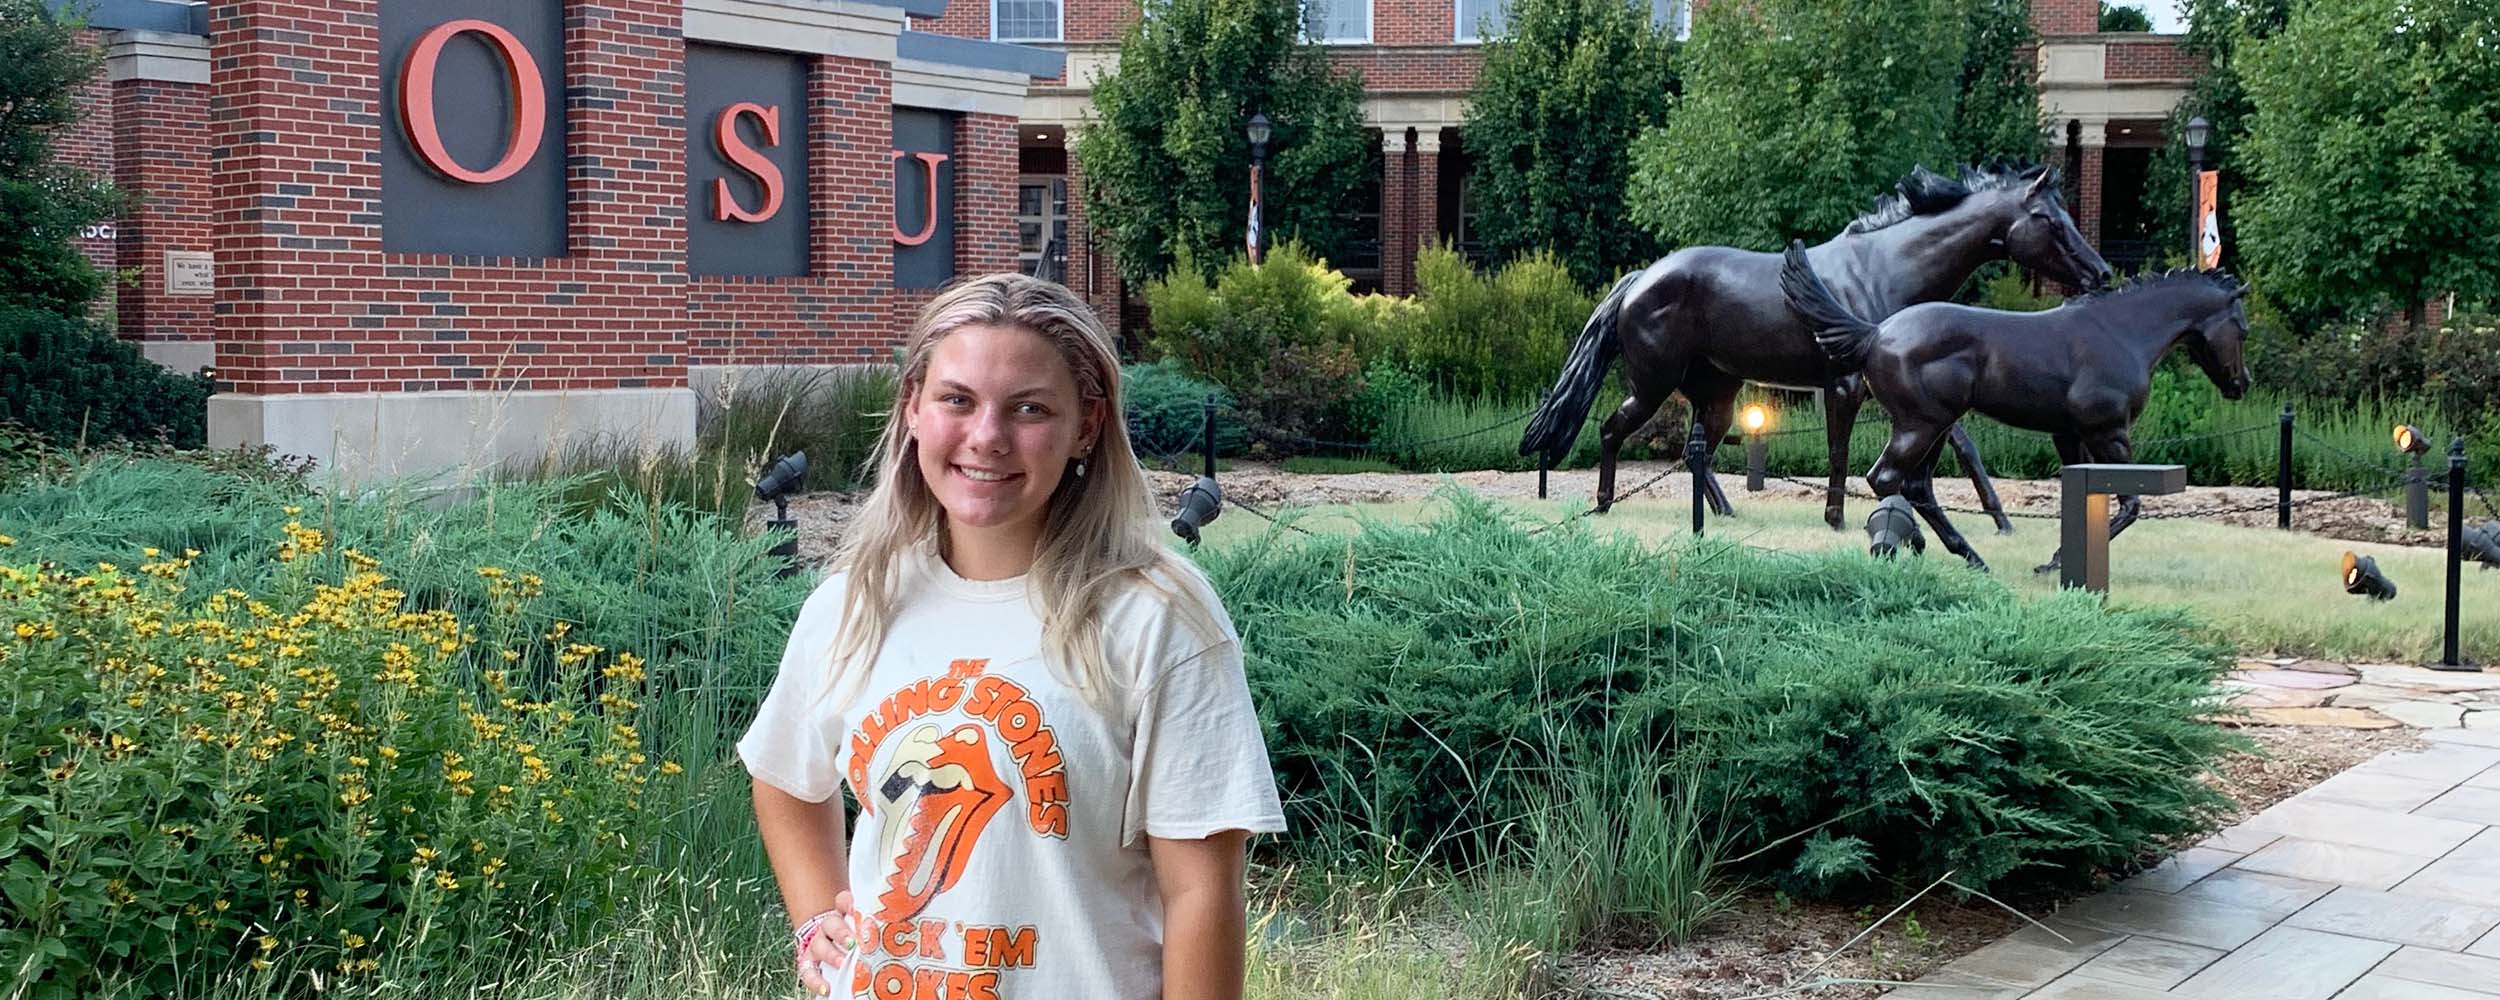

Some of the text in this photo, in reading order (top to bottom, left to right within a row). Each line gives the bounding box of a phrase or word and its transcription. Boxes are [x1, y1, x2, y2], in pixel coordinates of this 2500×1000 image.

[399, 19, 948, 246] O S U
[948, 658, 990, 679] THE
[847, 674, 1072, 839] OLLING STONES
[854, 911, 1038, 968] OCK 'EM
